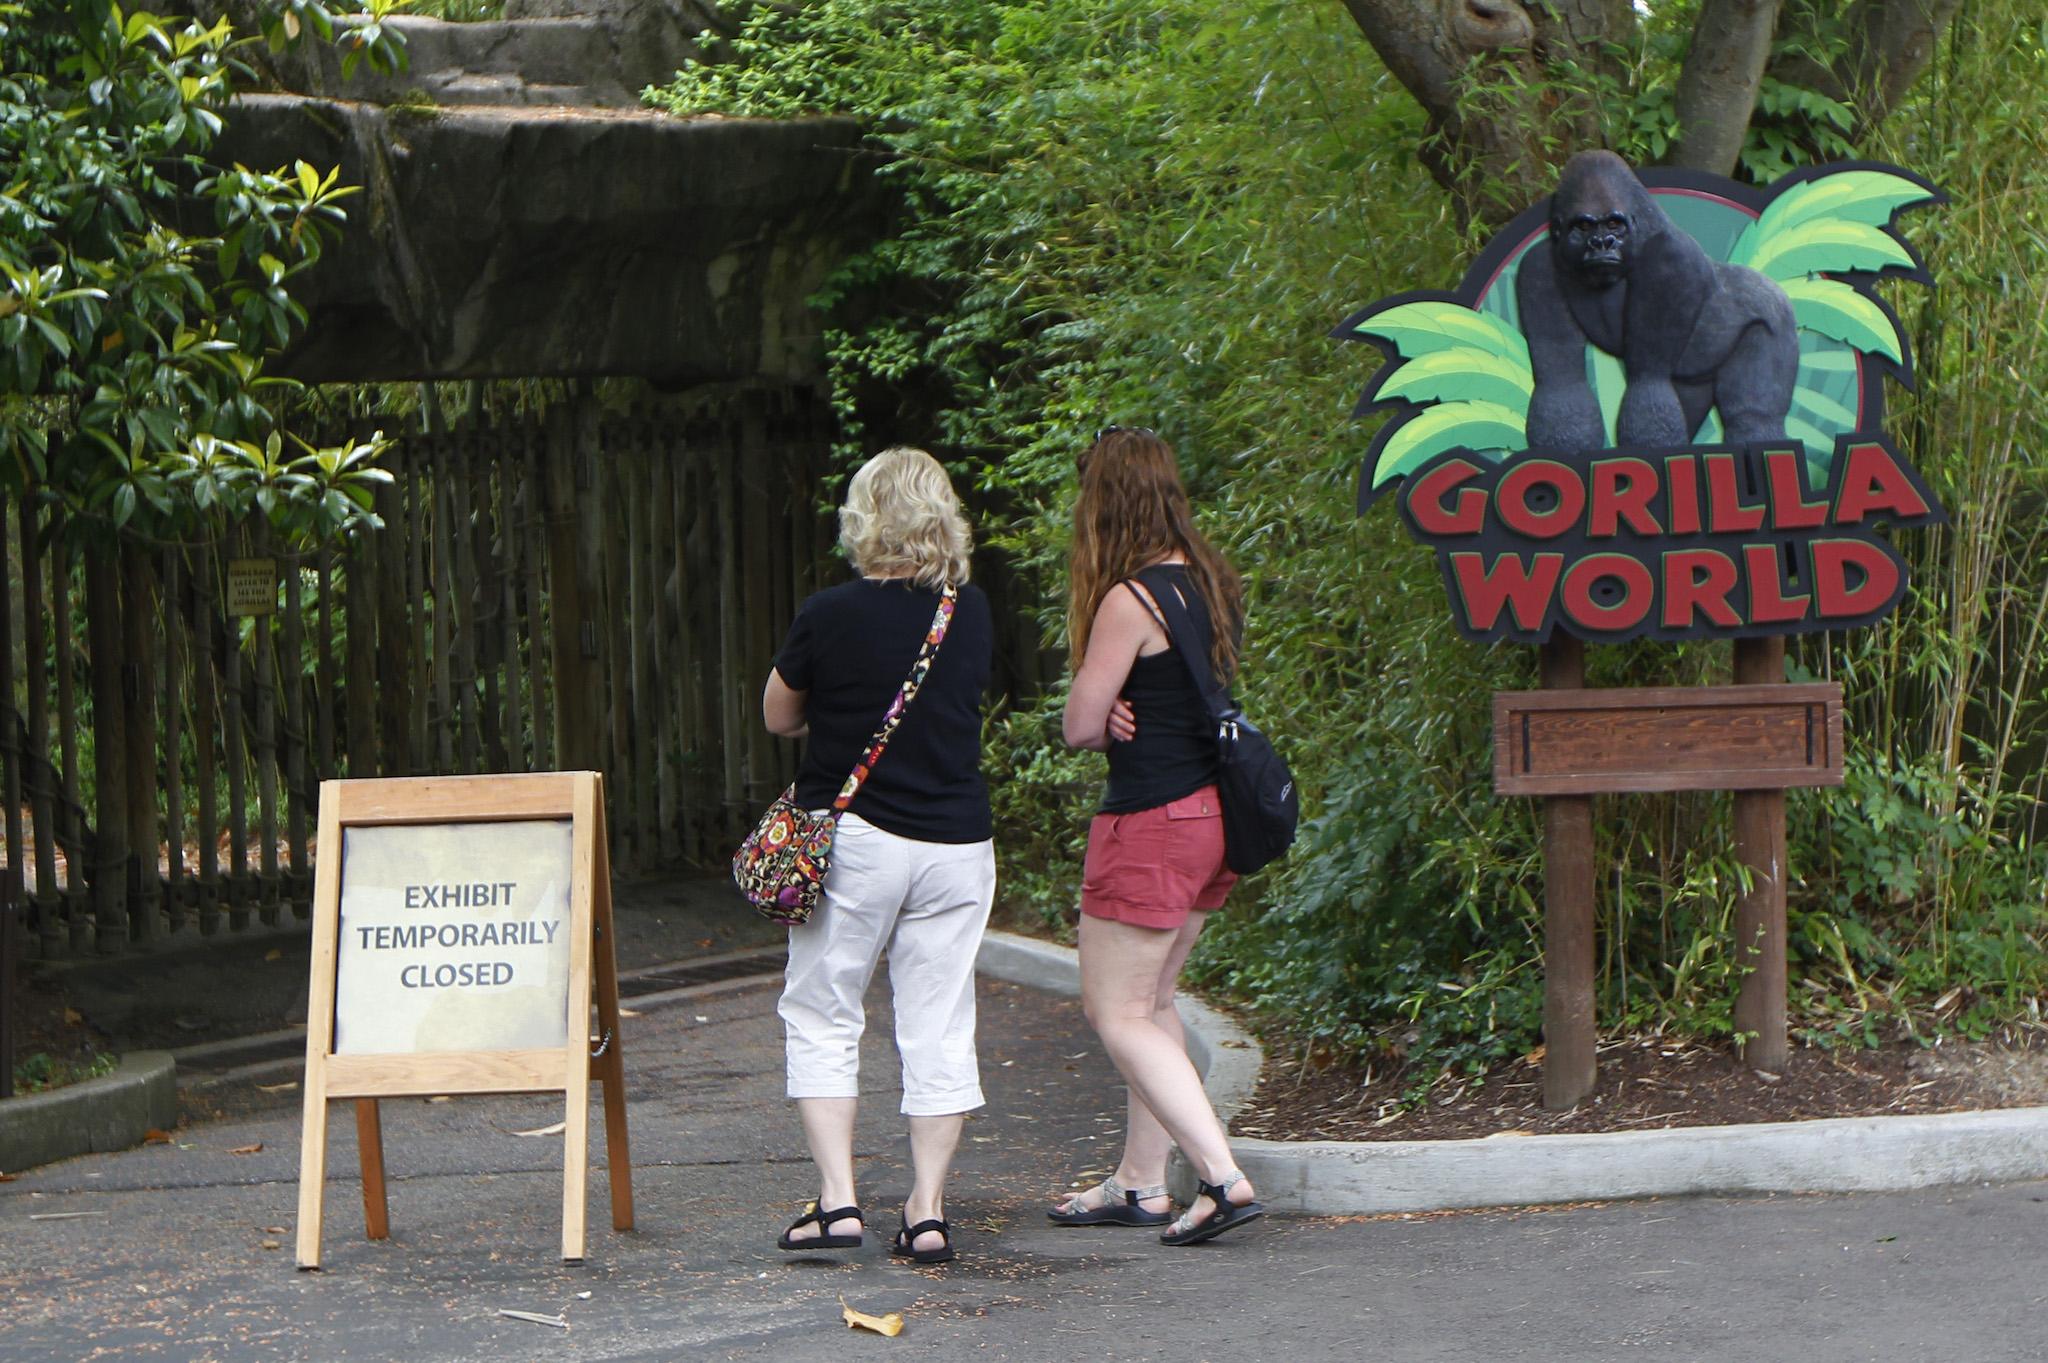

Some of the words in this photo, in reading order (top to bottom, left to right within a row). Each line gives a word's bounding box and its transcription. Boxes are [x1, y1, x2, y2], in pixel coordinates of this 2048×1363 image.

[1407, 442, 1932, 539] GORILLA
[1450, 537, 1899, 632] WORLD
[404, 882, 517, 909] EXHIBIT
[356, 919, 560, 950] TEMPORARILY
[400, 961, 514, 988] CLOSED
